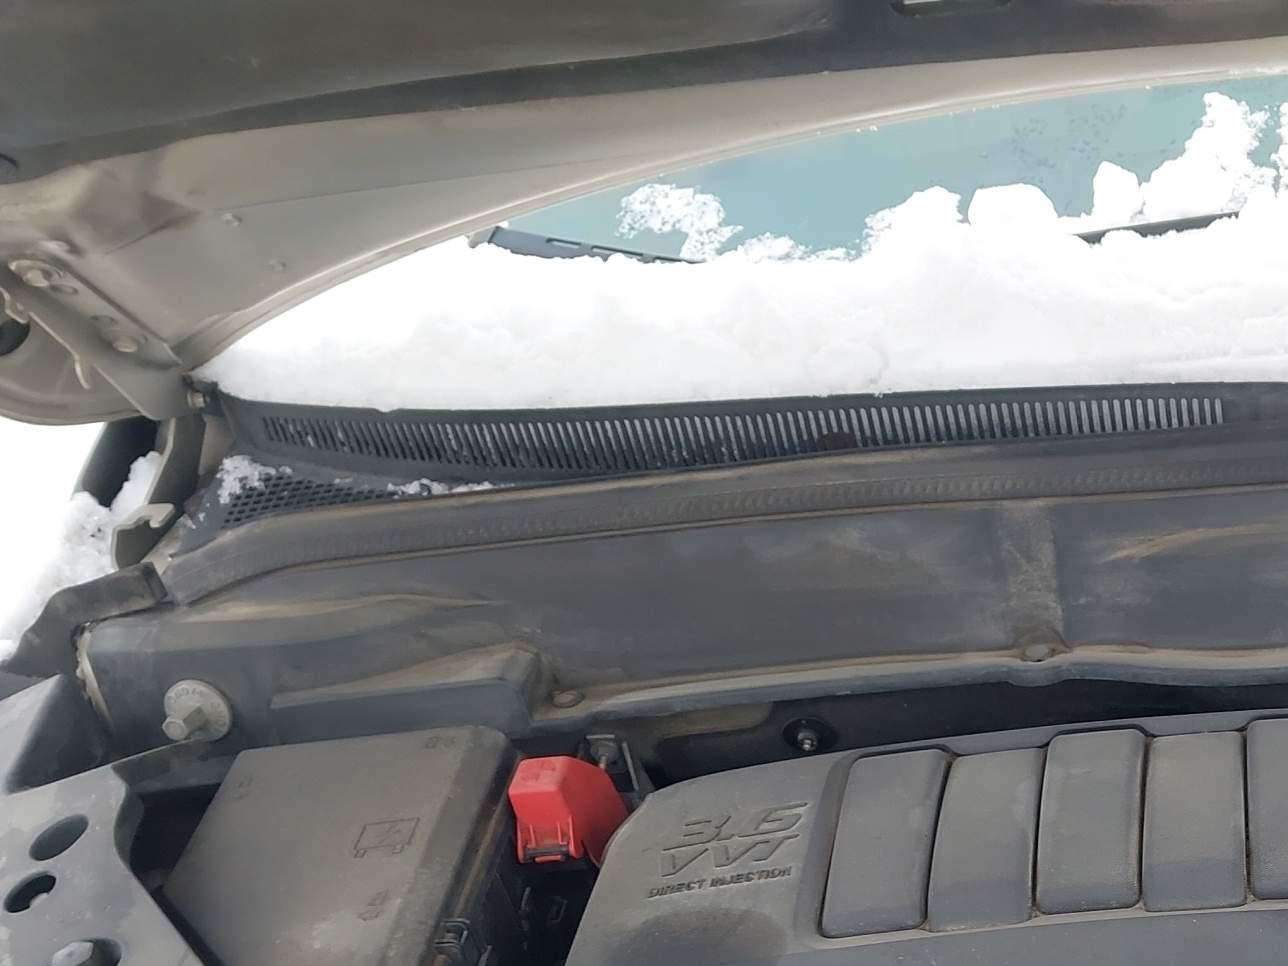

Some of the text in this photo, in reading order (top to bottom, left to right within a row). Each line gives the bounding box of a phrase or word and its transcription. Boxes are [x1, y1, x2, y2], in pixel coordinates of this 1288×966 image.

[661, 833, 800, 877] VVT
[648, 866, 792, 898] DIRECT INJECTION
